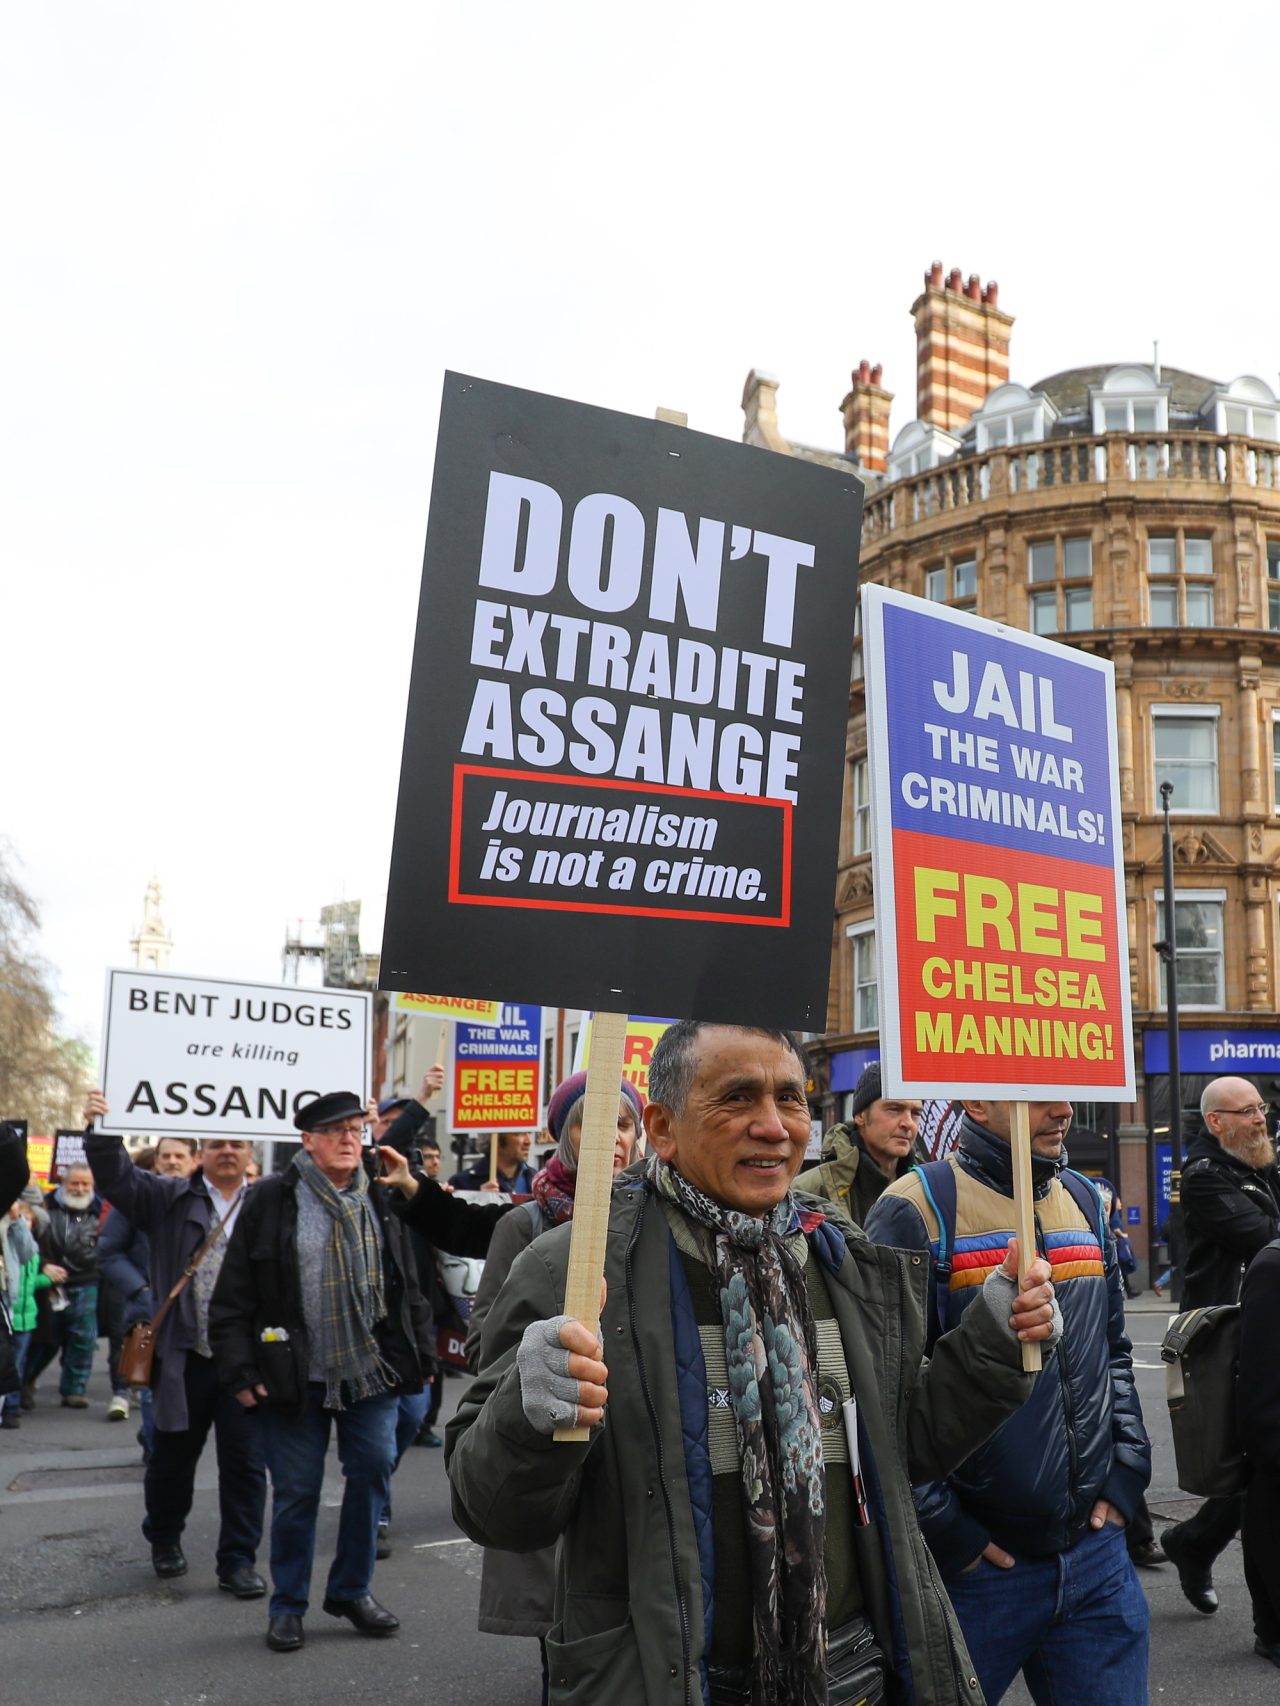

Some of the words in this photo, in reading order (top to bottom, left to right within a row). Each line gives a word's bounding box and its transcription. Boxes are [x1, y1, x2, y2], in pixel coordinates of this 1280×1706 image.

[478, 470, 816, 649] DON'T
[470, 599, 806, 725] EXTRADITE
[932, 650, 1073, 743] JAIL
[461, 678, 801, 806] ASSANGE
[924, 722, 999, 773] THE
[1009, 743, 1084, 794] WAR
[481, 790, 718, 851] Journalism
[901, 772, 1105, 846] CRIMINALS!
[479, 839, 524, 882] is
[529, 848, 605, 889] not
[608, 856, 637, 891] a
[643, 857, 767, 902] crime.
[914, 866, 1106, 962] FREE
[129, 988, 220, 1018] BENT
[230, 998, 352, 1031] JUDGES
[922, 956, 1106, 1011] CHELSEA
[186, 1042, 224, 1058] are
[231, 1042, 300, 1067] killing
[458, 1043, 538, 1056] CRIMINALS!
[468, 1028, 496, 1040] THE
[499, 1028, 530, 1041] WAR
[915, 1011, 1114, 1060] MANNING!
[125, 1080, 321, 1120] ASSAN
[460, 1069, 534, 1091] FREE
[461, 1093, 532, 1106] CHELSEA
[457, 1108, 534, 1121] MANNING!
